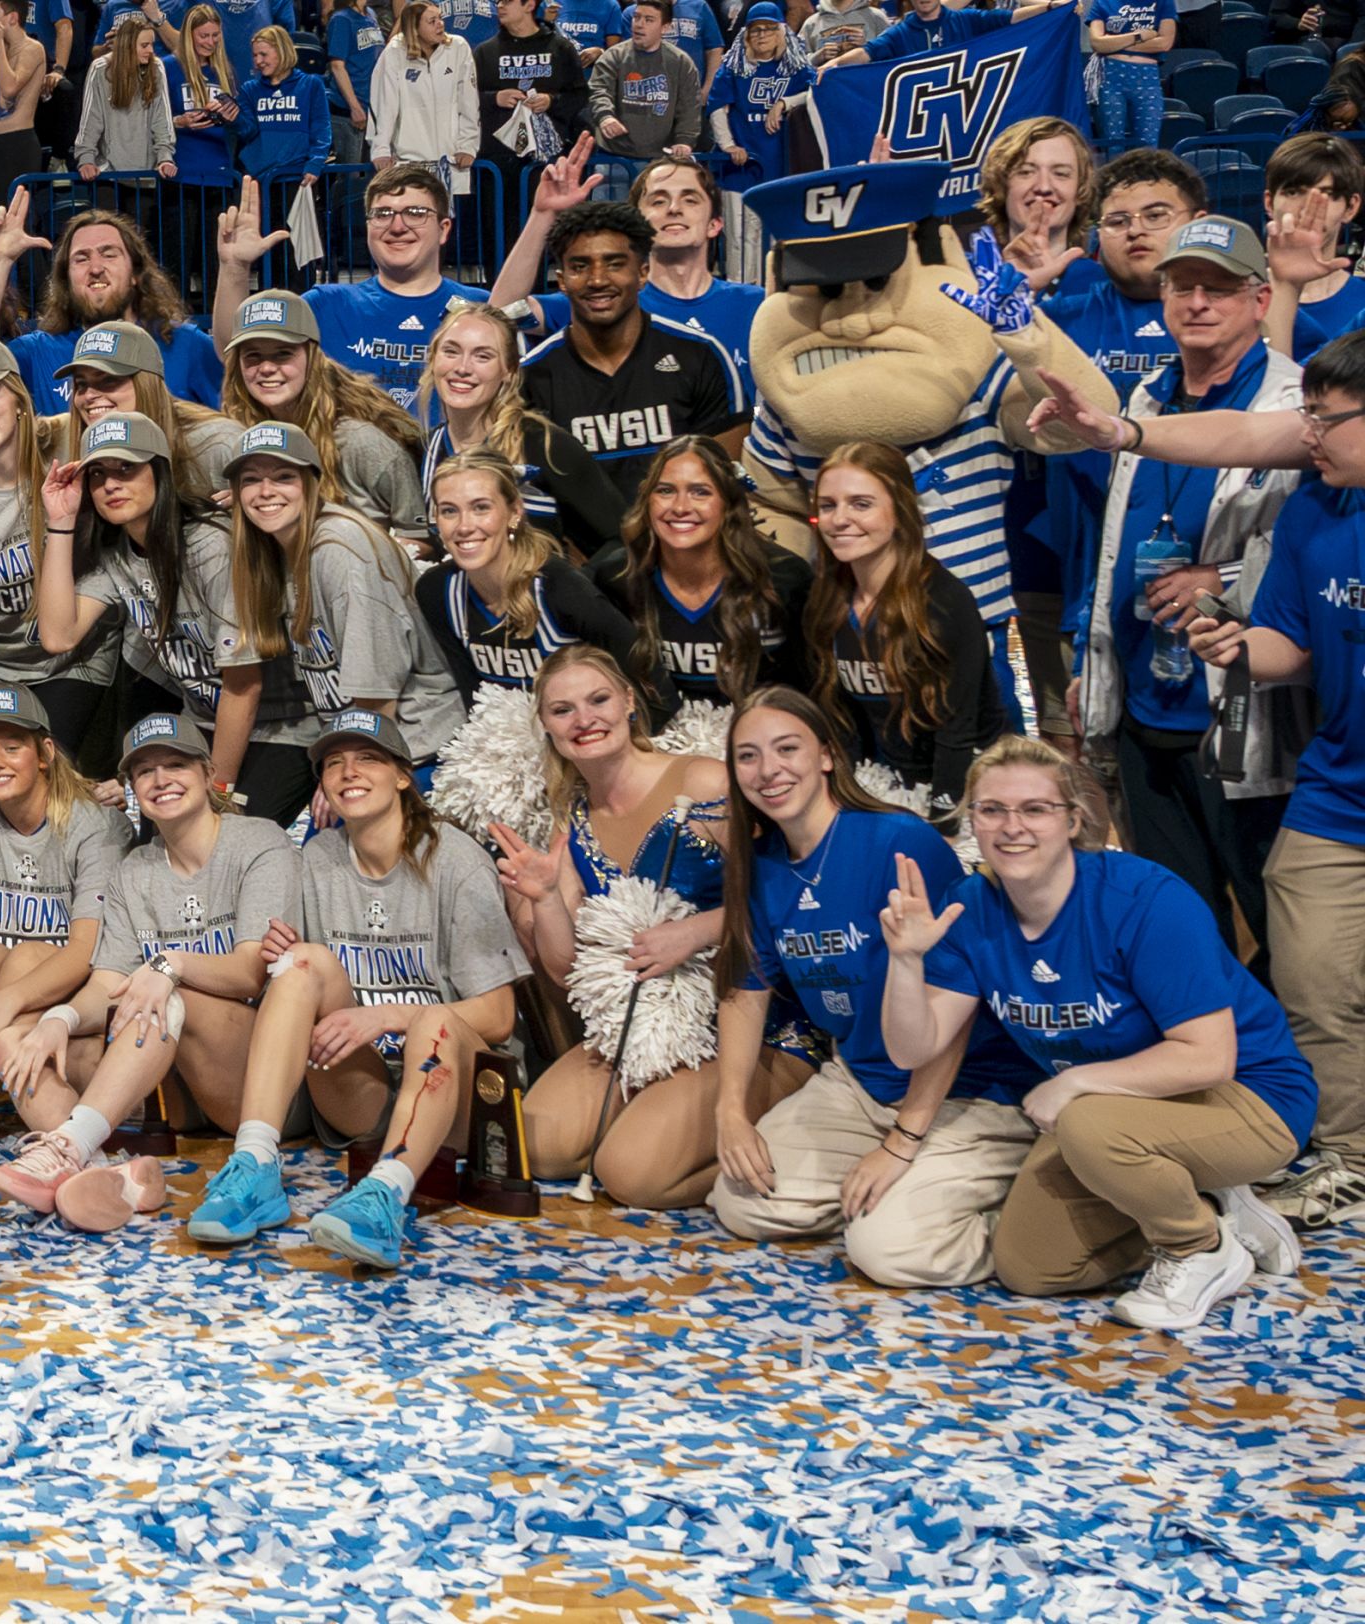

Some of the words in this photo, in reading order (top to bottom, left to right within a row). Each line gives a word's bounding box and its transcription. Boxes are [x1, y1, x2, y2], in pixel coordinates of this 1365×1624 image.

[561, 22, 598, 34] AKERS
[499, 53, 552, 68] GVSU
[748, 76, 791, 110] GV
[257, 95, 297, 112] GVSU
[879, 46, 1029, 173] GV
[937, 172, 982, 199] VALL
[805, 183, 865, 229] GV
[251, 301, 282, 312] NATIONAL
[250, 311, 282, 322] CHAMPIONS
[86, 331, 116, 342] NATIONAL
[83, 340, 114, 353] CHAMPIONS
[371, 343, 430, 364] PULS
[96, 421, 126, 433] NATIONAL
[249, 427, 283, 438] NATIONAL
[571, 404, 672, 452] GVSU
[94, 430, 127, 444] CHAMPIONS
[249, 435, 284, 448] CHAMPIONS
[469, 642, 543, 679] GVSU
[661, 640, 723, 675] GVS
[140, 717, 170, 729] NATIONAL
[137, 930, 154, 940] 2025
[784, 930, 847, 960] PULSE
[330, 941, 436, 987] ATIONAL
[1008, 1001, 1093, 1031] PULSE
